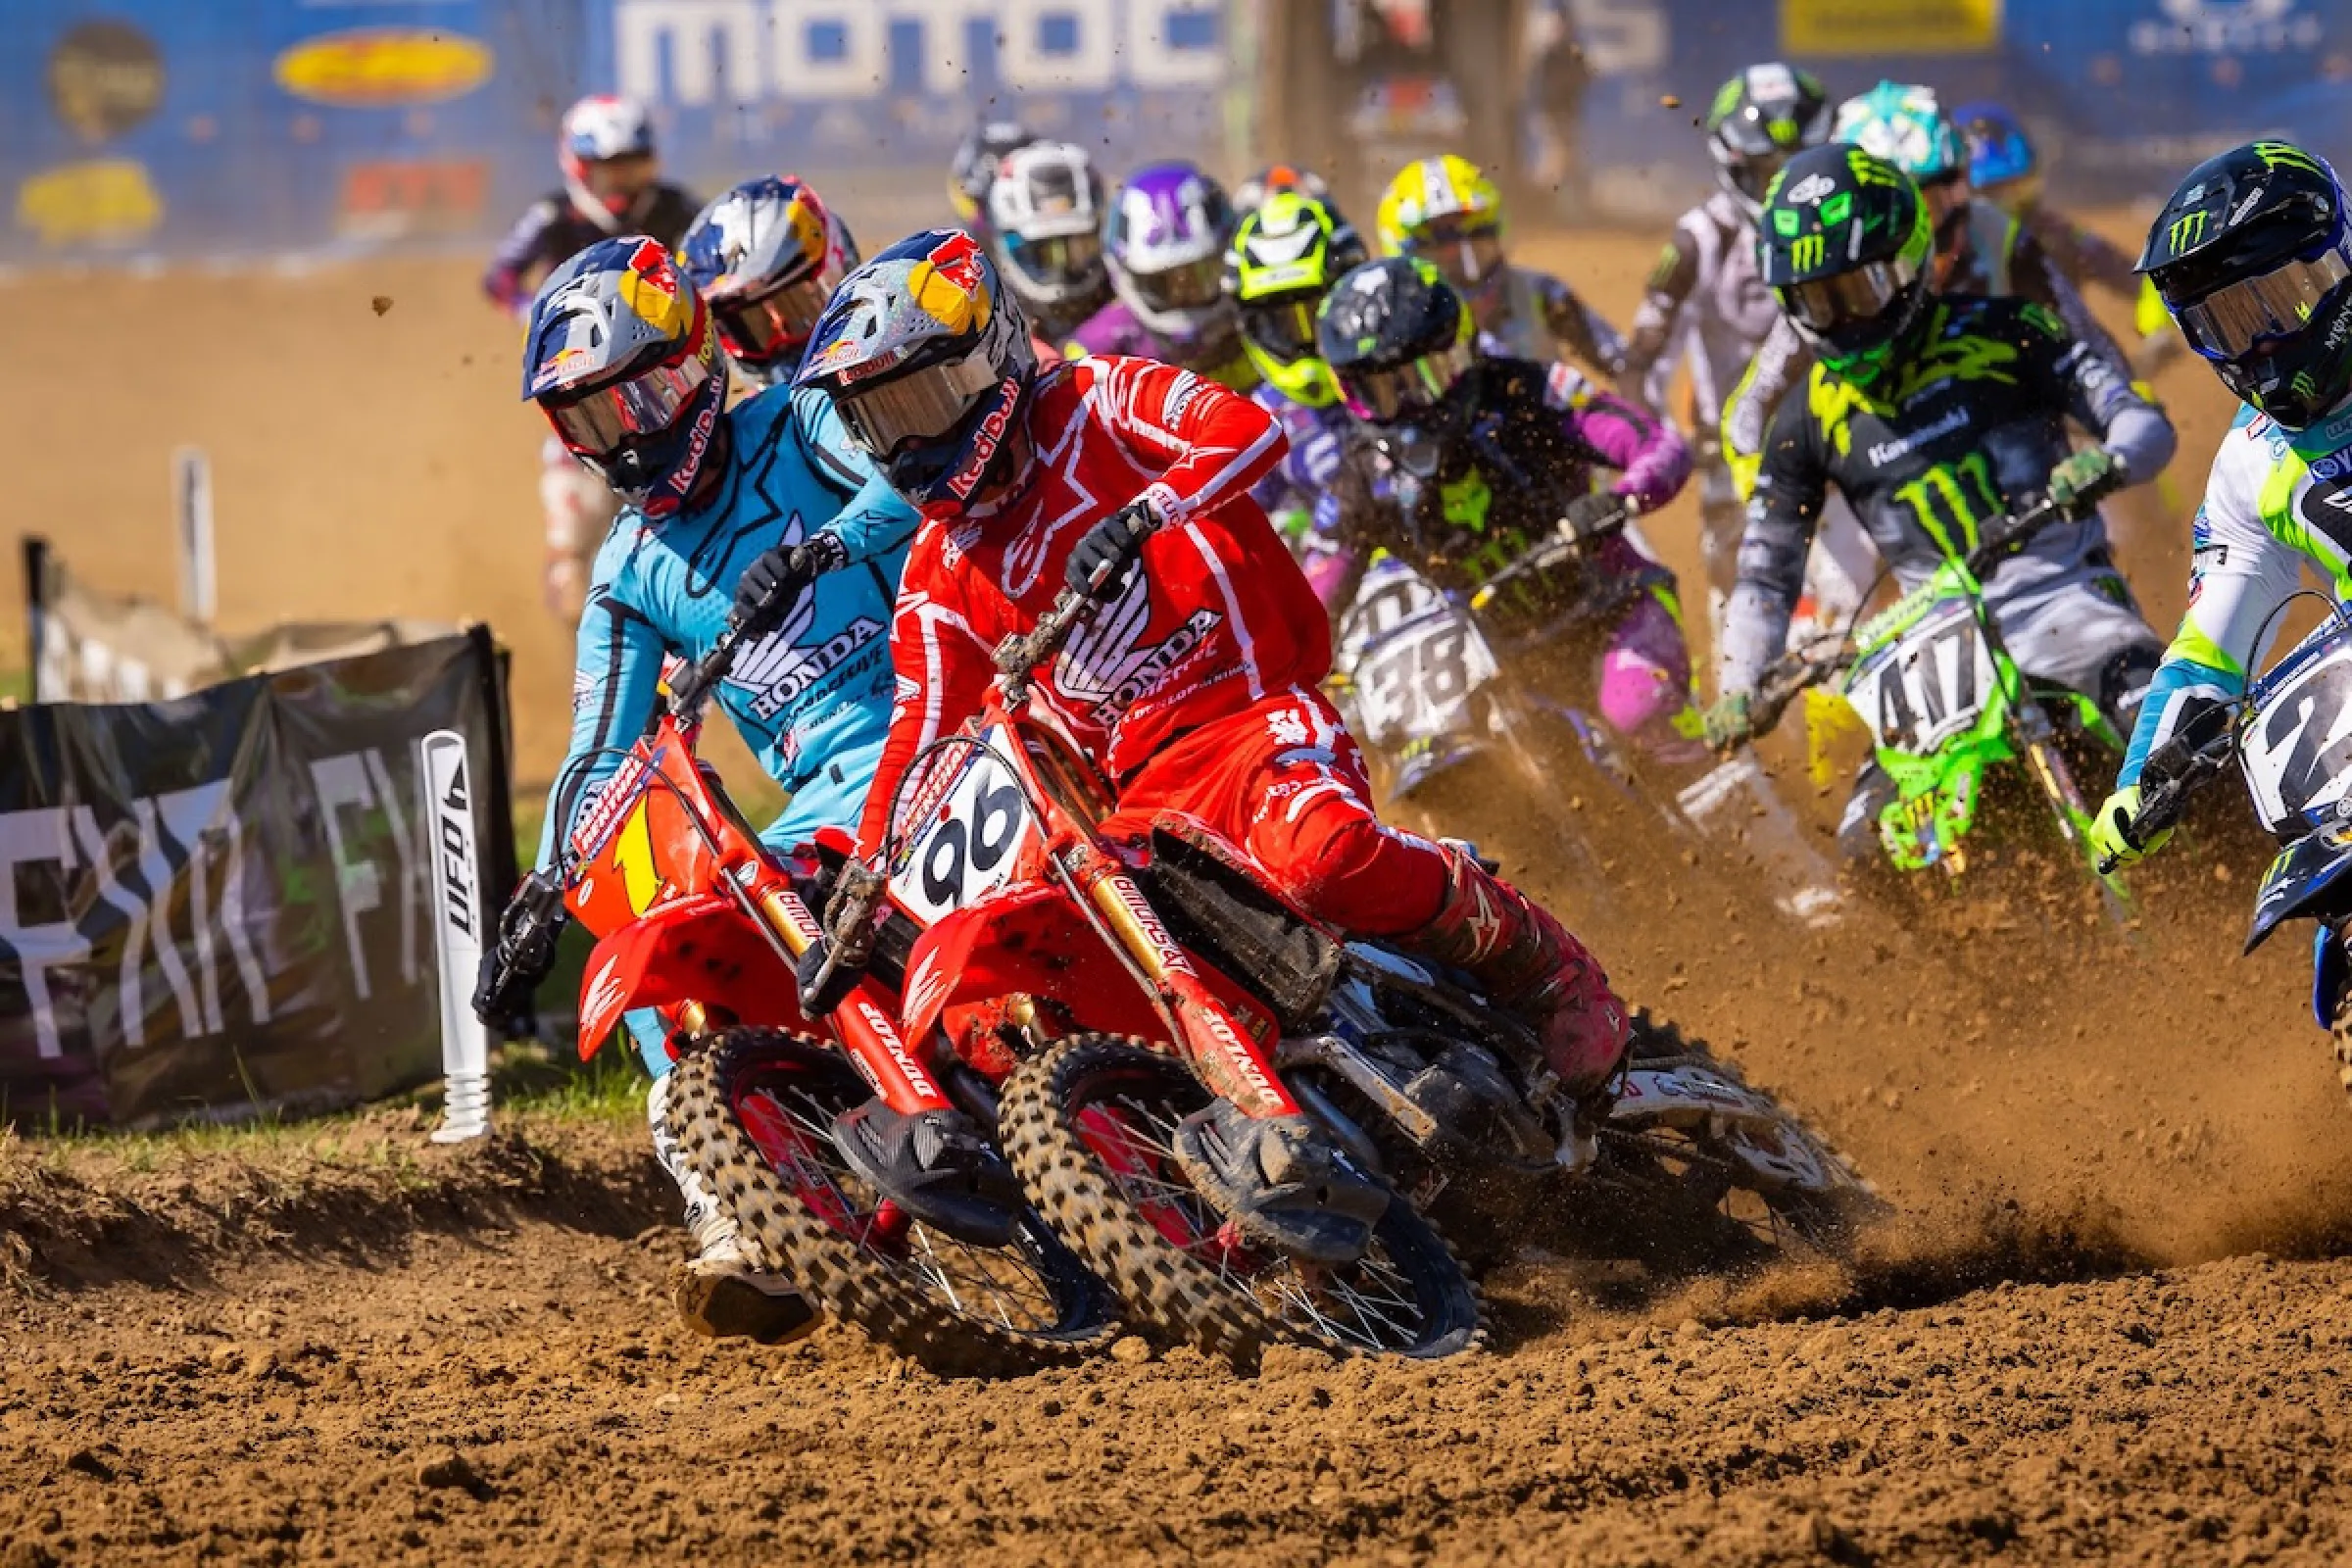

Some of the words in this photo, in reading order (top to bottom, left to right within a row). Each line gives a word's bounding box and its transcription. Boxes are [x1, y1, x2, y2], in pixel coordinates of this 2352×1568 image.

[748, 615, 885, 720] HONDA
[1090, 608, 1223, 728] HONDA
[444, 815, 472, 937] UFO
[612, 795, 666, 918] 1
[921, 764, 1024, 911] 96
[858, 1001, 938, 1099] DUNLOP
[1201, 1007, 1283, 1106] DUNLOP
